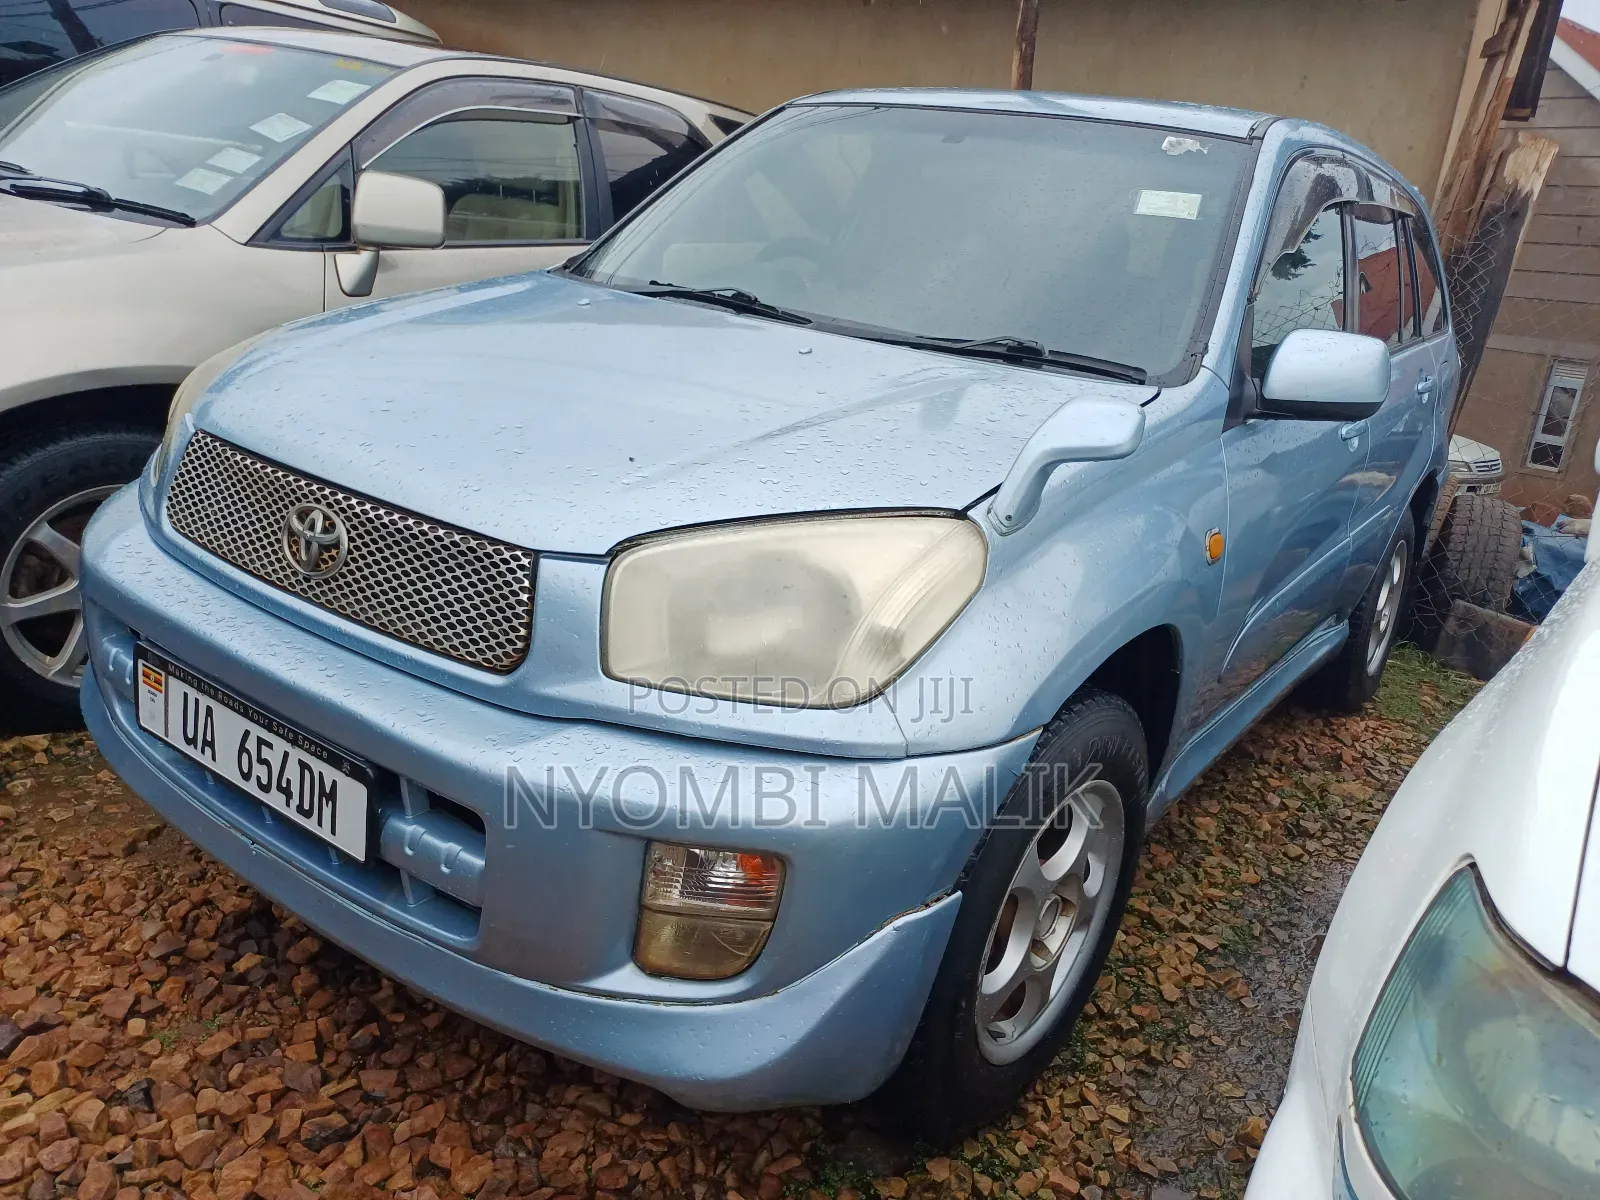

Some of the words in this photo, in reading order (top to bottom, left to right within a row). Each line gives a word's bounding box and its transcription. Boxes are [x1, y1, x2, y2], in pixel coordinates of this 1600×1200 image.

[168, 662, 198, 688] Making
[201, 681, 215, 697] the
[218, 690, 244, 713] Roads
[248, 706, 269, 726] Your
[272, 721, 294, 740] Safe
[297, 735, 328, 759] Space
[182, 690, 217, 763] UA
[237, 728, 338, 837] 654DM
